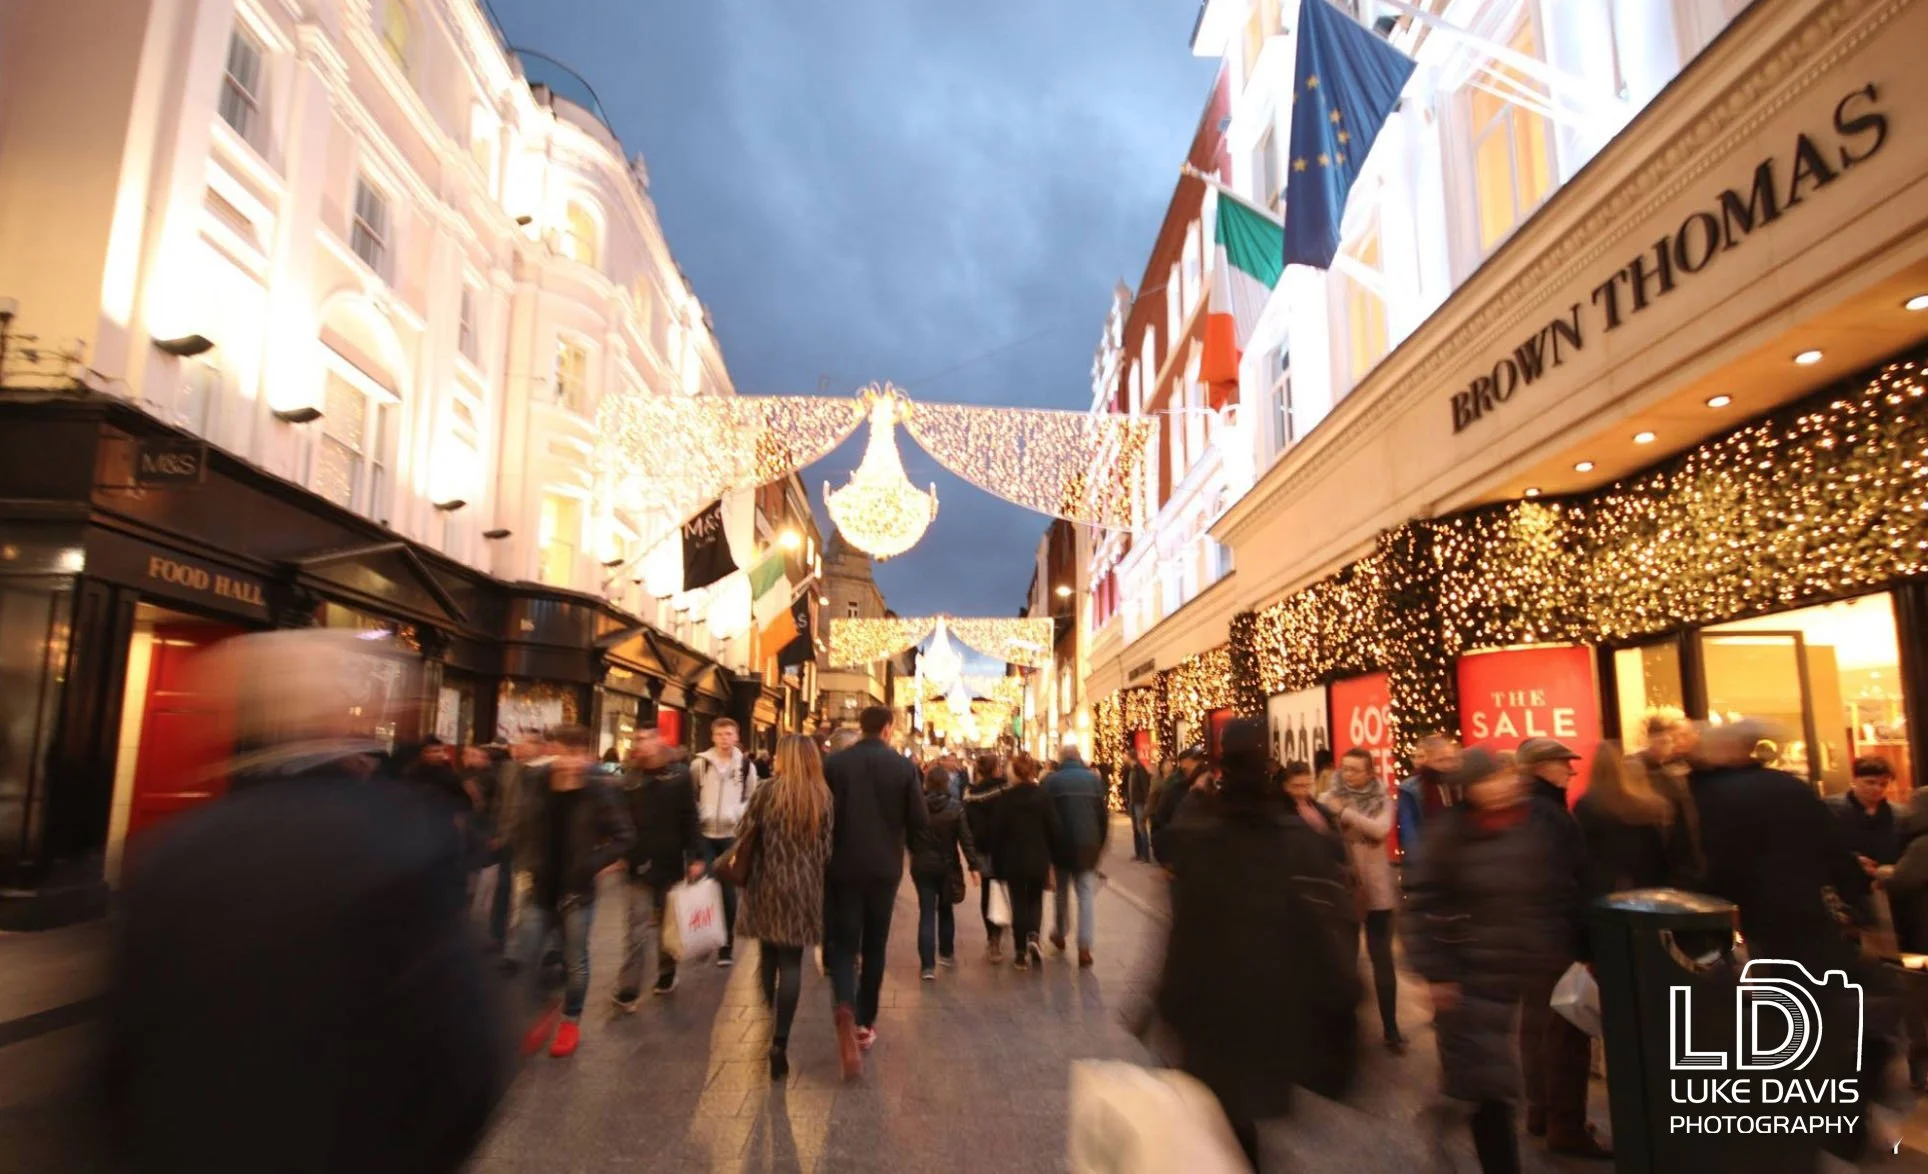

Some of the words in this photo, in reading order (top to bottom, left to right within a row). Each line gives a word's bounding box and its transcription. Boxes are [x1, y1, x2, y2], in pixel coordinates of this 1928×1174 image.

[1450, 304, 1583, 434] BROWN
[1592, 83, 1888, 333] THOMAS
[141, 453, 197, 476] M&S
[148, 555, 210, 590] FOOD
[214, 574, 267, 607] HALL
[1491, 688, 1546, 708] THE
[1472, 707, 1577, 738] SALE
